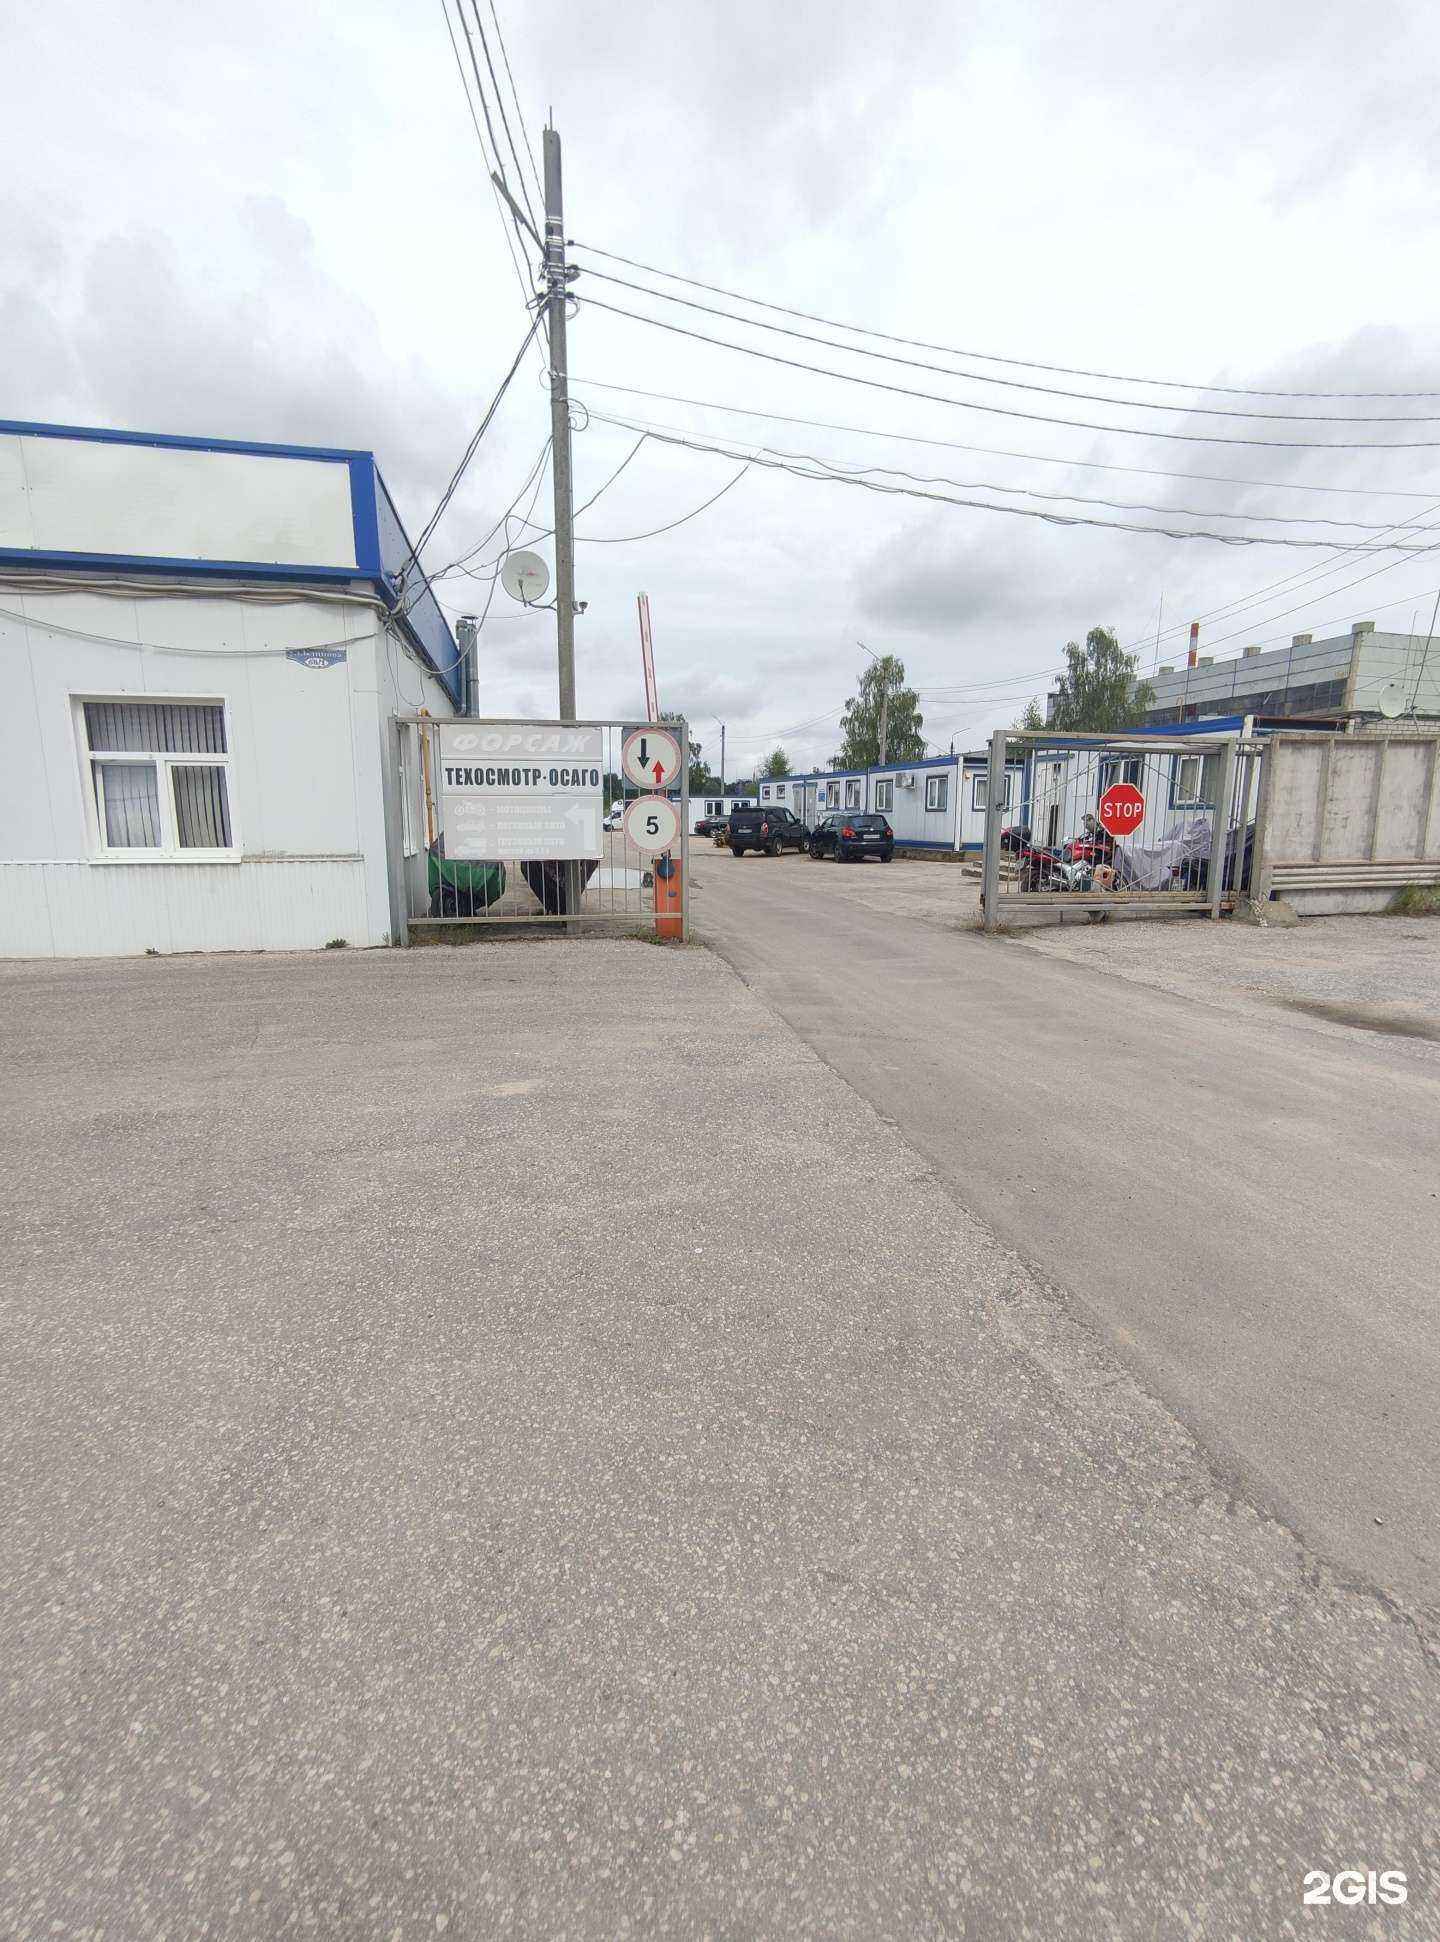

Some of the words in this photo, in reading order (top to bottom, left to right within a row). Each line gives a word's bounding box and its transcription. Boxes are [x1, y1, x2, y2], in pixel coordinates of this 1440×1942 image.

[452, 733, 592, 753] ФОРСАЖ
[1104, 802, 1142, 818] STOP
[646, 815, 659, 835] 5
